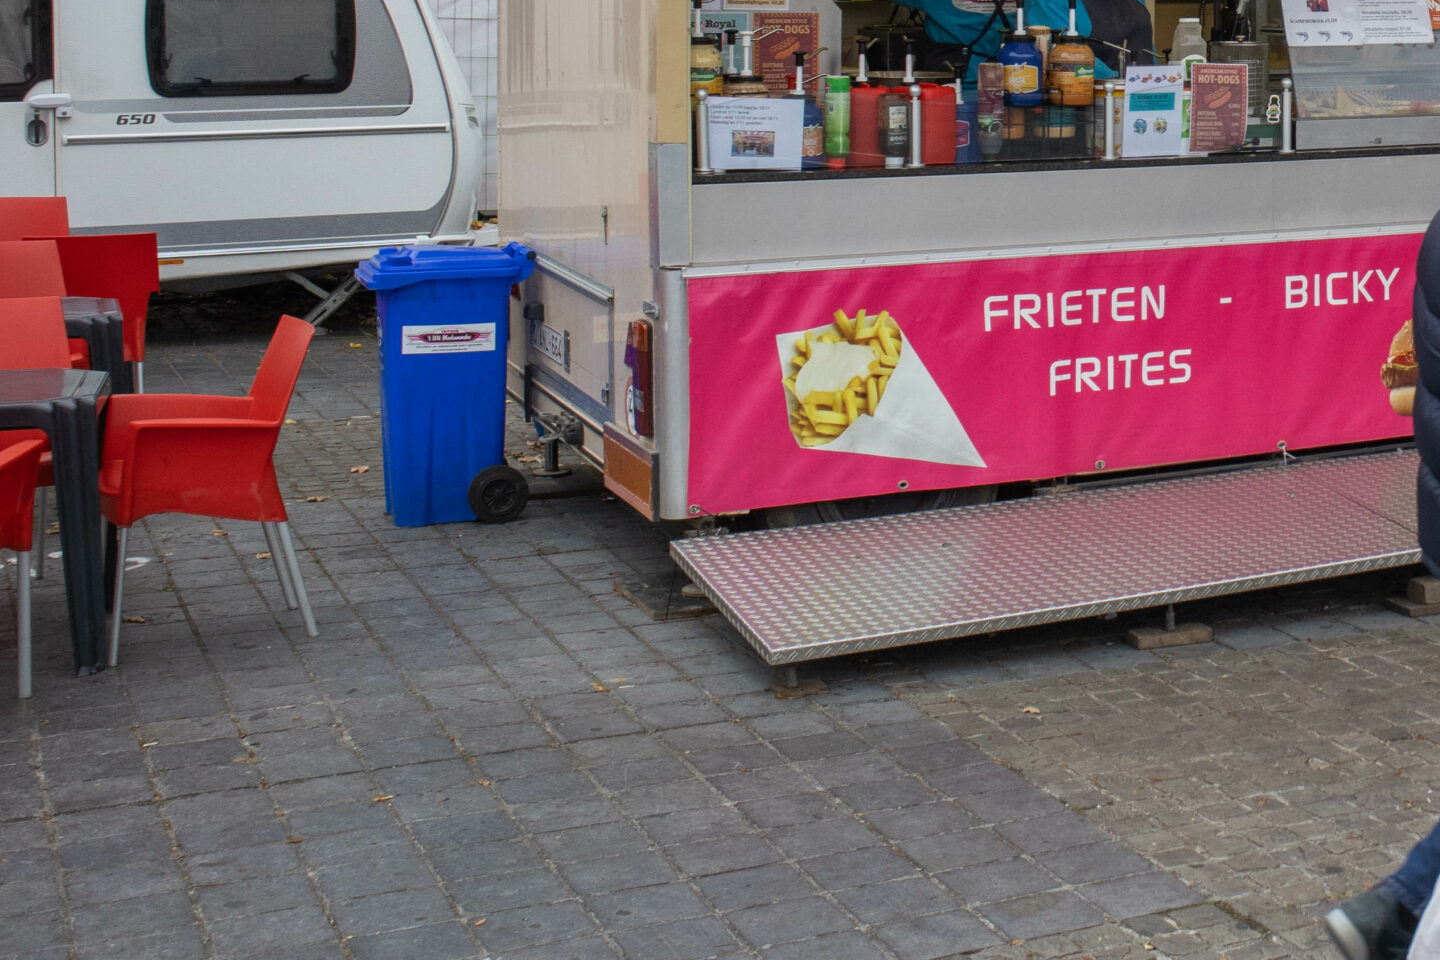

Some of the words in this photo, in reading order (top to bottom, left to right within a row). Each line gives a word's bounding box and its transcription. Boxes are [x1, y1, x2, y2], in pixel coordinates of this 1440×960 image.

[704, 19, 736, 30] Royal
[1197, 74, 1241, 85] HOT-DOGS
[115, 112, 156, 127] 650
[983, 284, 1166, 333] FRIETEN
[1284, 266, 1400, 310] BICKY
[1049, 348, 1193, 397] FRITES
